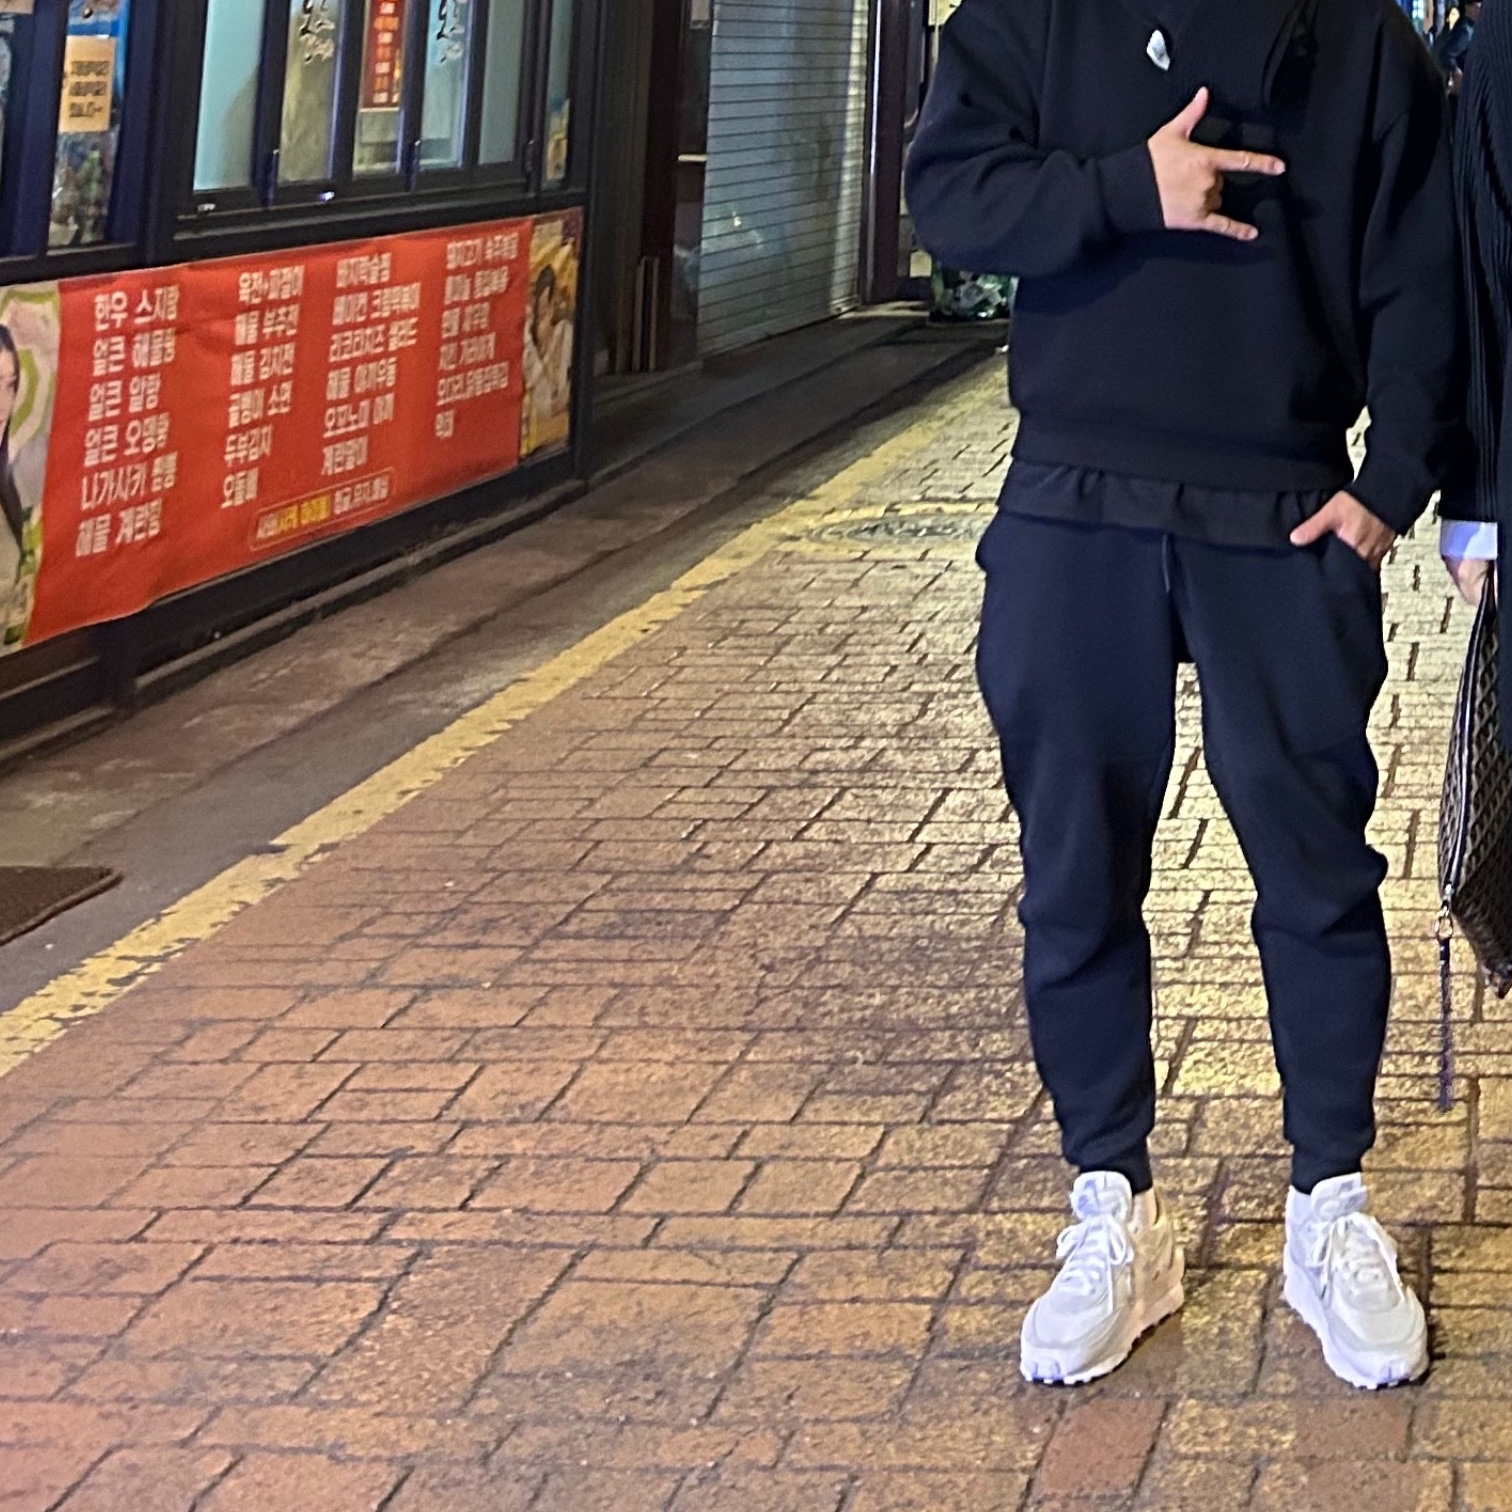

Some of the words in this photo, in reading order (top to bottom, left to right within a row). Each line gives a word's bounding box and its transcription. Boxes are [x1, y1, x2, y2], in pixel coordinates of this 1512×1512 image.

[94, 291, 129, 332] 한우
[92, 335, 126, 377] 얼큰
[88, 379, 123, 422] 얼큰
[84, 424, 119, 468] 얼큰
[224, 422, 272, 468] 두부김치
[81, 461, 147, 512] 나가사키
